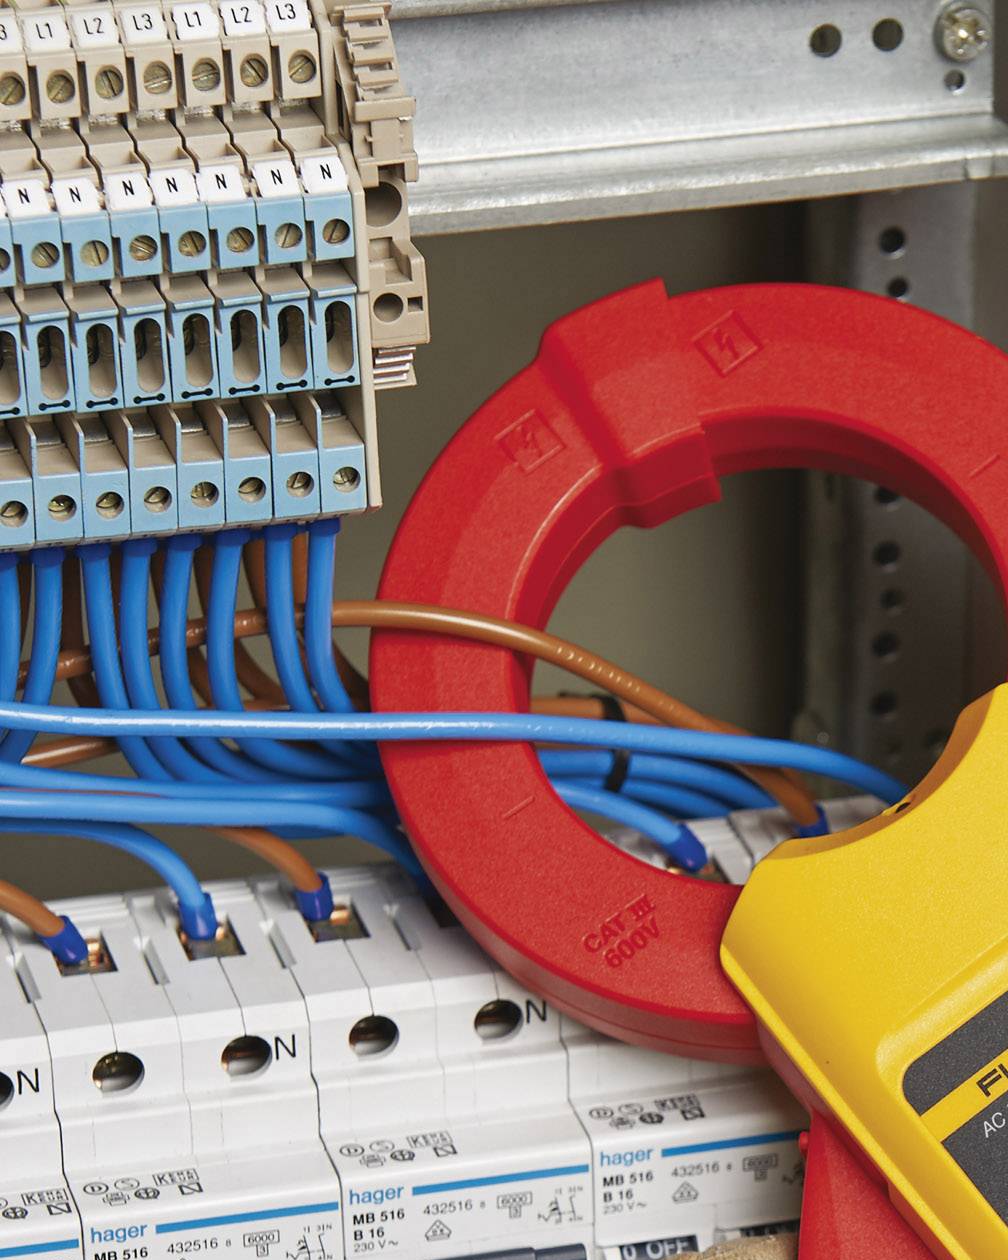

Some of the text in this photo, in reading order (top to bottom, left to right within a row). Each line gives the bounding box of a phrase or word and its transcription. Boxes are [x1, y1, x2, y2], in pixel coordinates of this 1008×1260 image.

[36, 23, 53, 39] L1
[83, 17, 105, 35] L2
[133, 14, 153, 31] L3
[185, 11, 203, 28] L1
[232, 6, 251, 24] L2
[276, 3, 297, 21] L3
[18, 163, 332, 204] N N N N N N N
[583, 912, 625, 953] CAT
[604, 915, 659, 968] 600V
[525, 999, 547, 1024] N
[274, 1034, 297, 1060] N
[17, 1068, 39, 1095] N
[982, 1114, 1008, 1138] AC
[600, 1149, 653, 1167] hager
[603, 1171, 654, 1187] MB 516
[349, 1186, 404, 1205] hager
[604, 1189, 633, 1202] B 16
[353, 1208, 405, 1226] MB 516
[423, 1200, 473, 1216] 432516
[91, 1224, 147, 1244] hager
[354, 1227, 384, 1241] B 16
[123, 1247, 148, 1260] 516
[167, 1238, 219, 1255] 432516
[354, 1242, 375, 1253] 230
[646, 1240, 688, 1260] OFF
